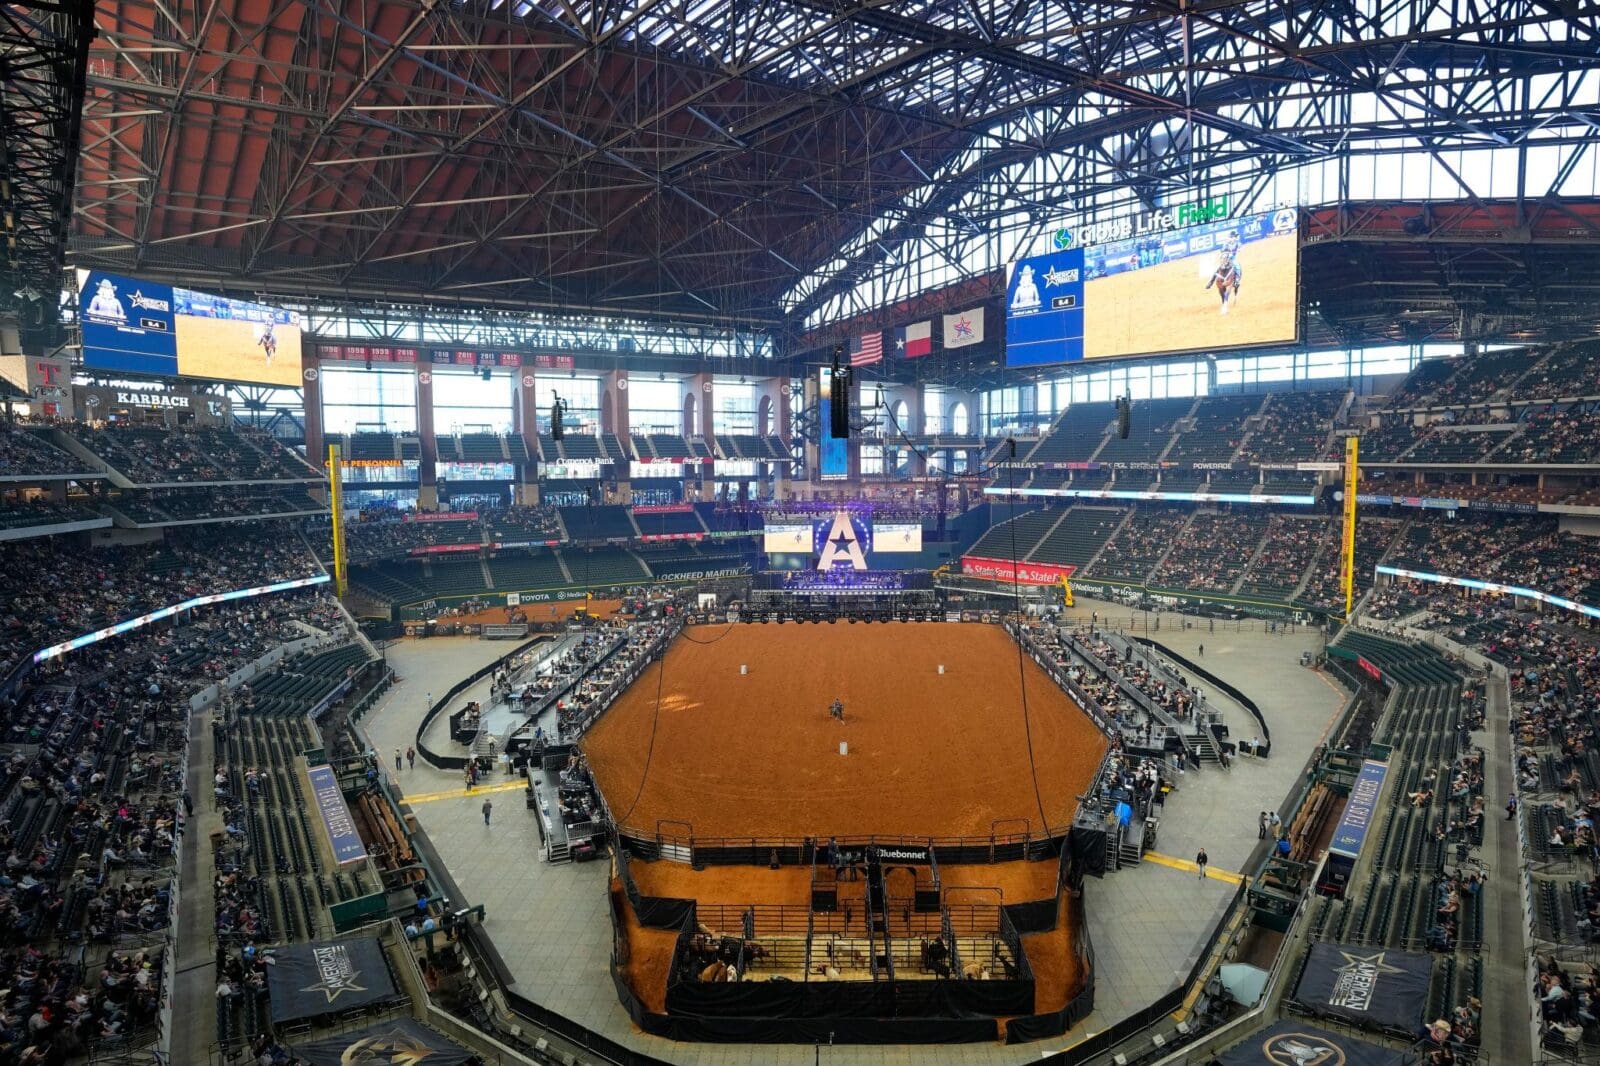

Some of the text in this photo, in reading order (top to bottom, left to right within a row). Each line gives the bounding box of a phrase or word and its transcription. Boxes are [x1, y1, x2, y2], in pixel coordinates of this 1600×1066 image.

[1136, 211, 1174, 234] Life
[1178, 194, 1228, 225] Field
[1192, 237, 1213, 250] JCB
[117, 392, 190, 408] KARBACH
[351, 459, 402, 468] PERSONNEL
[595, 456, 615, 465] Bank
[1192, 462, 1232, 470] POWERADE
[656, 569, 739, 582] LOCKHEED MARTIN
[1075, 583, 1104, 594] National
[520, 593, 550, 602] TOYOTA
[316, 946, 345, 988] AMERICAN
[1345, 961, 1377, 1011] AMERICAN
